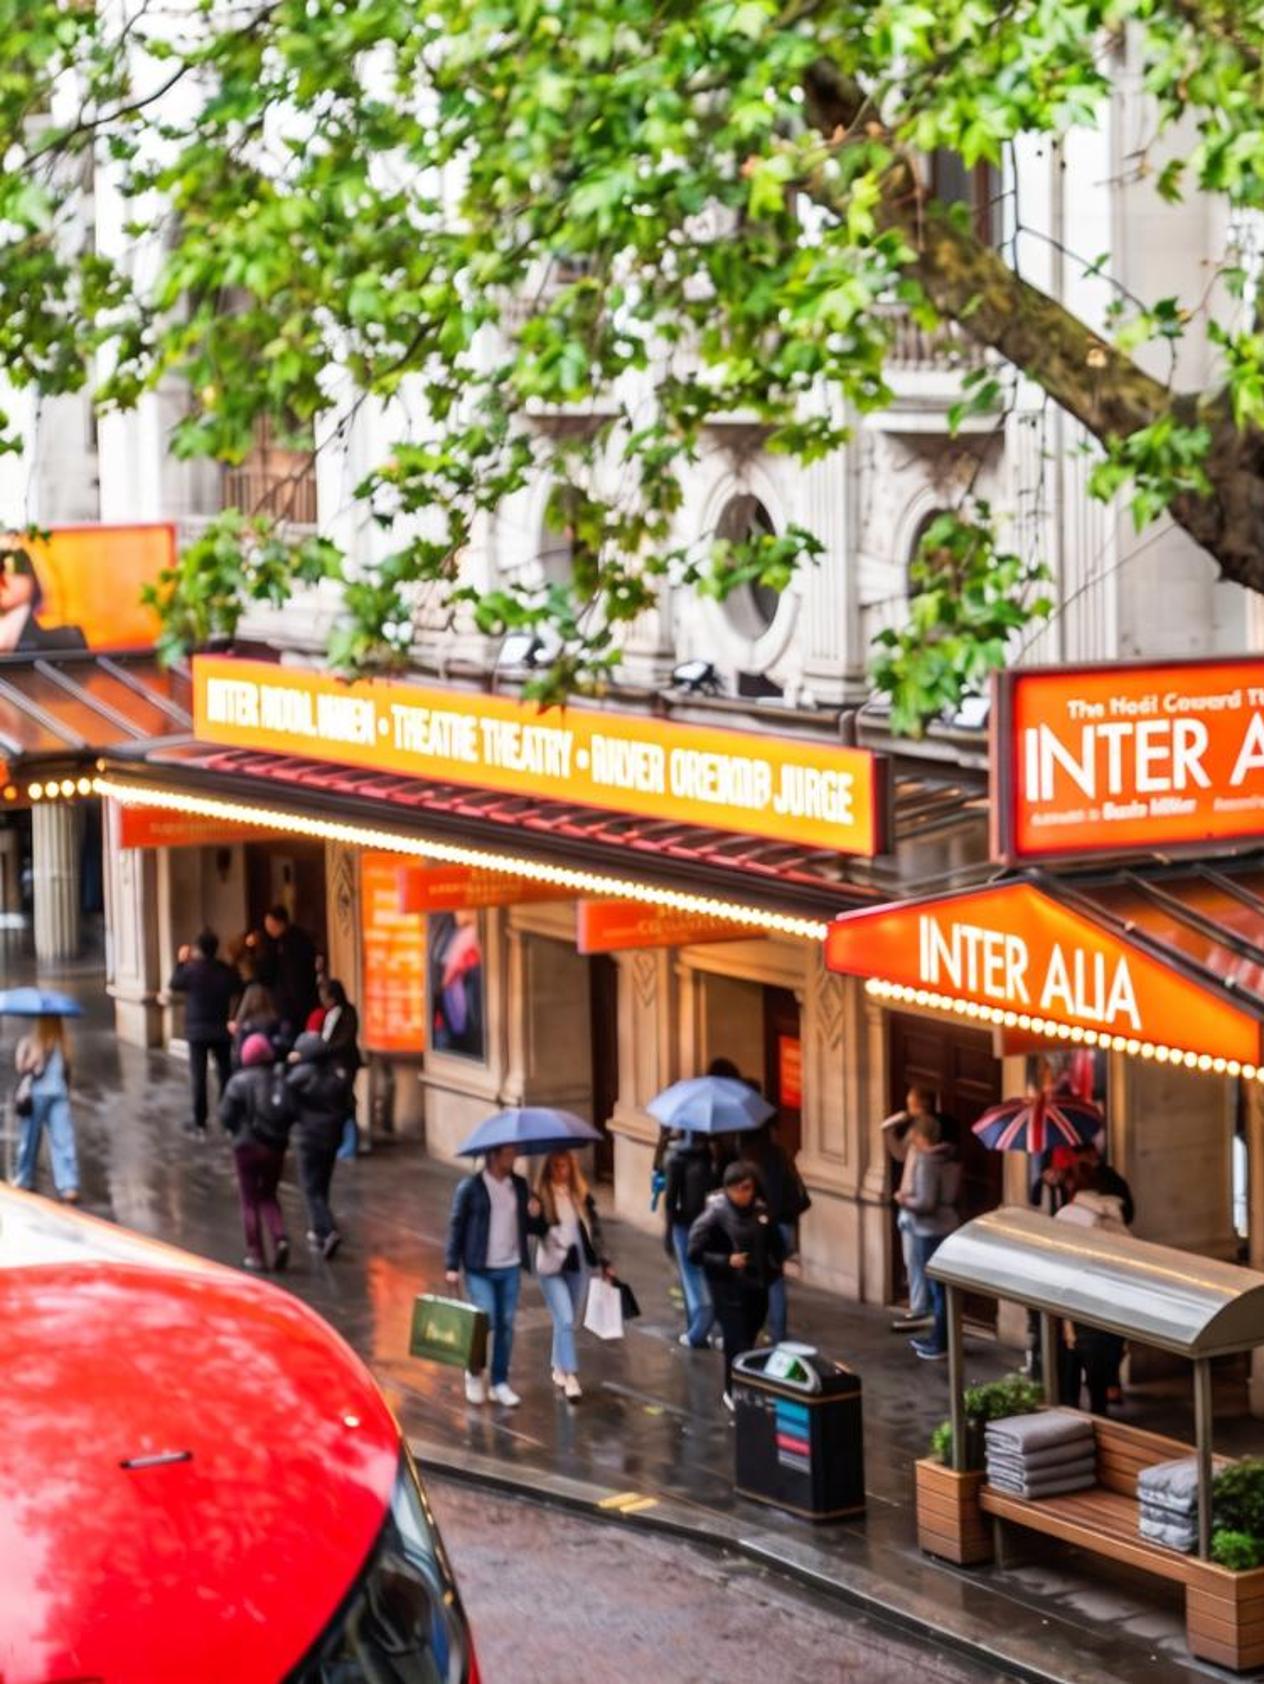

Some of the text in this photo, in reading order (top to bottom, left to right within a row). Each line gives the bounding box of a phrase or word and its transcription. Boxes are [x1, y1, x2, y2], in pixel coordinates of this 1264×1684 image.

[1025, 717, 1212, 801] INTER
[919, 915, 1142, 1031] INTER ALIA
